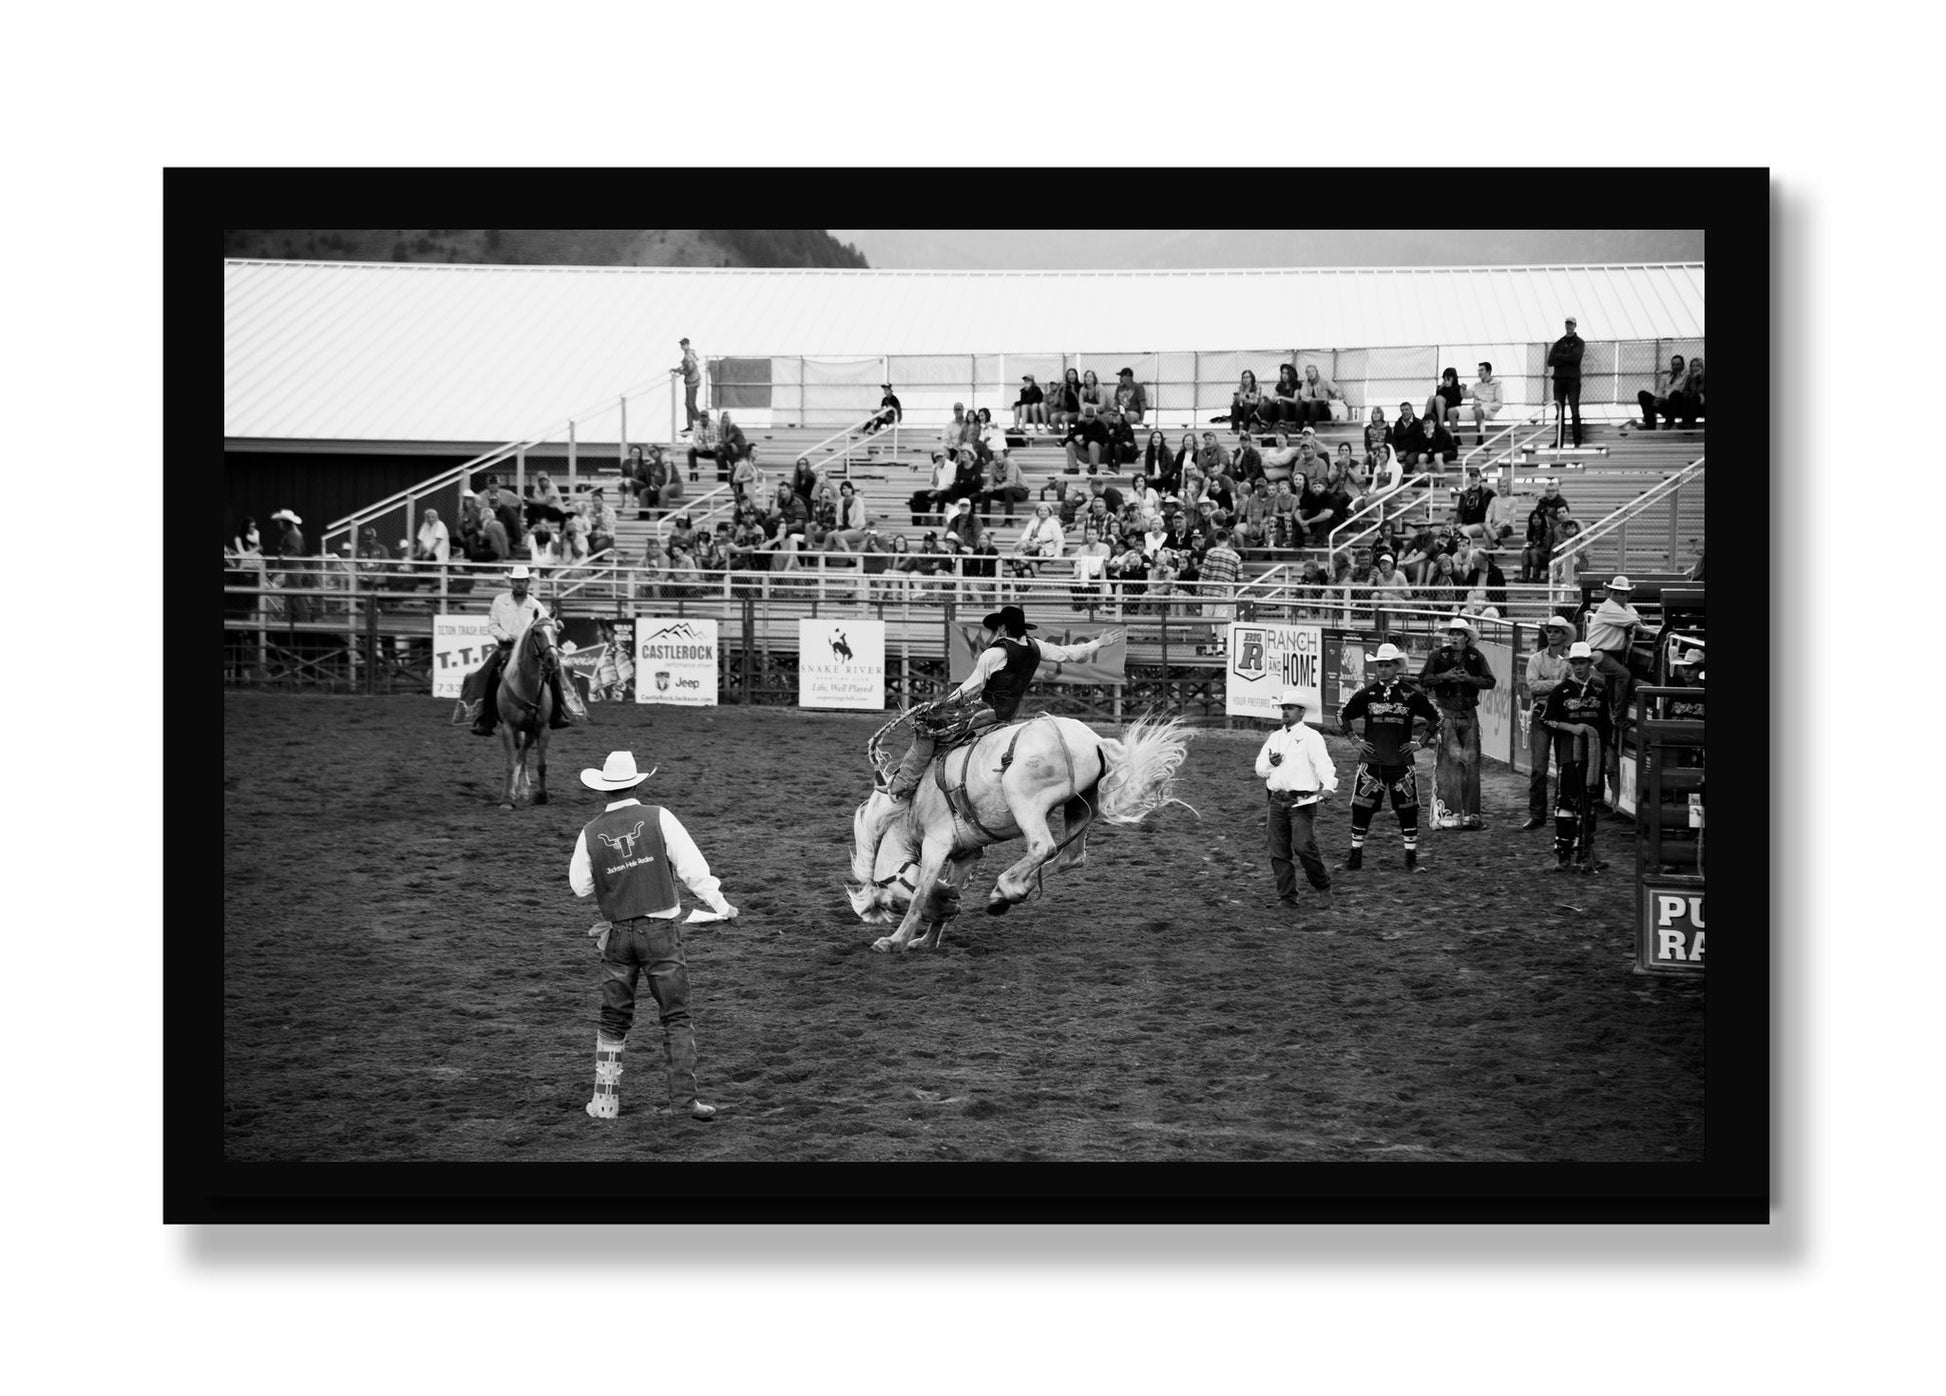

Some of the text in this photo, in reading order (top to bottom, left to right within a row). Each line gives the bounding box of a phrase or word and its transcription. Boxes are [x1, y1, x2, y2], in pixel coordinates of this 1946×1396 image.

[1267, 629, 1317, 652] RANCH
[642, 644, 713, 660] CASTLEROCK
[801, 665, 882, 675] SNAKE RIVER
[1282, 652, 1318, 688] HOME
[675, 677, 700, 690] Jeep
[606, 856, 654, 875] Jackson Hole Rodeo
